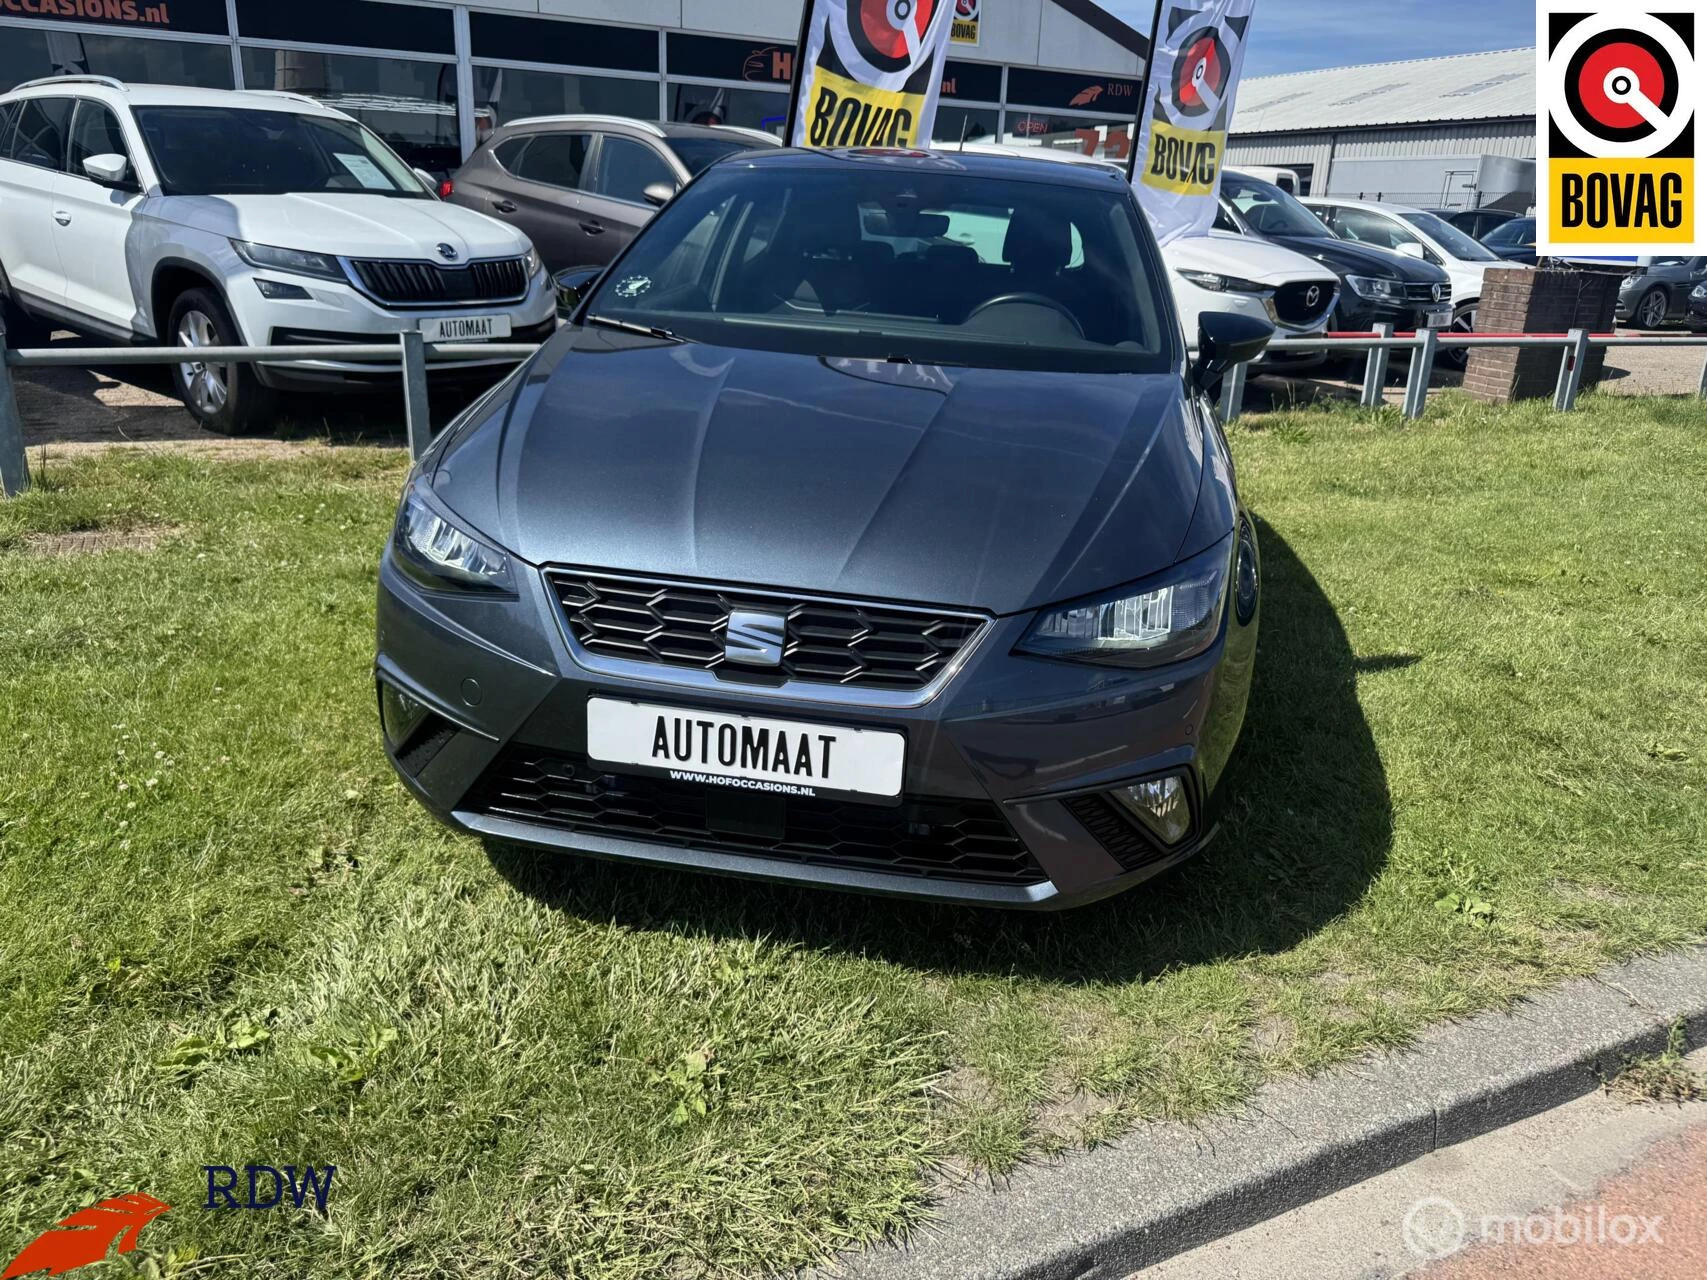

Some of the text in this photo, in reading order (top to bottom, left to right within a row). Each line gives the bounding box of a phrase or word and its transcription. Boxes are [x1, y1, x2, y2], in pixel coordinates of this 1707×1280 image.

[0, 0, 169, 23] CCASIONS.nl
[951, 23, 976, 39] BOVAG
[1107, 83, 1133, 96] RDW
[810, 86, 912, 147] BOVAG
[1017, 121, 1048, 133] OPEN
[1151, 133, 1216, 185] BOVAG
[440, 319, 493, 338] AUTOMAAT
[652, 715, 836, 779] AUTOMAAT
[670, 770, 816, 798] WWW.HOFOCCASIONS.NL
